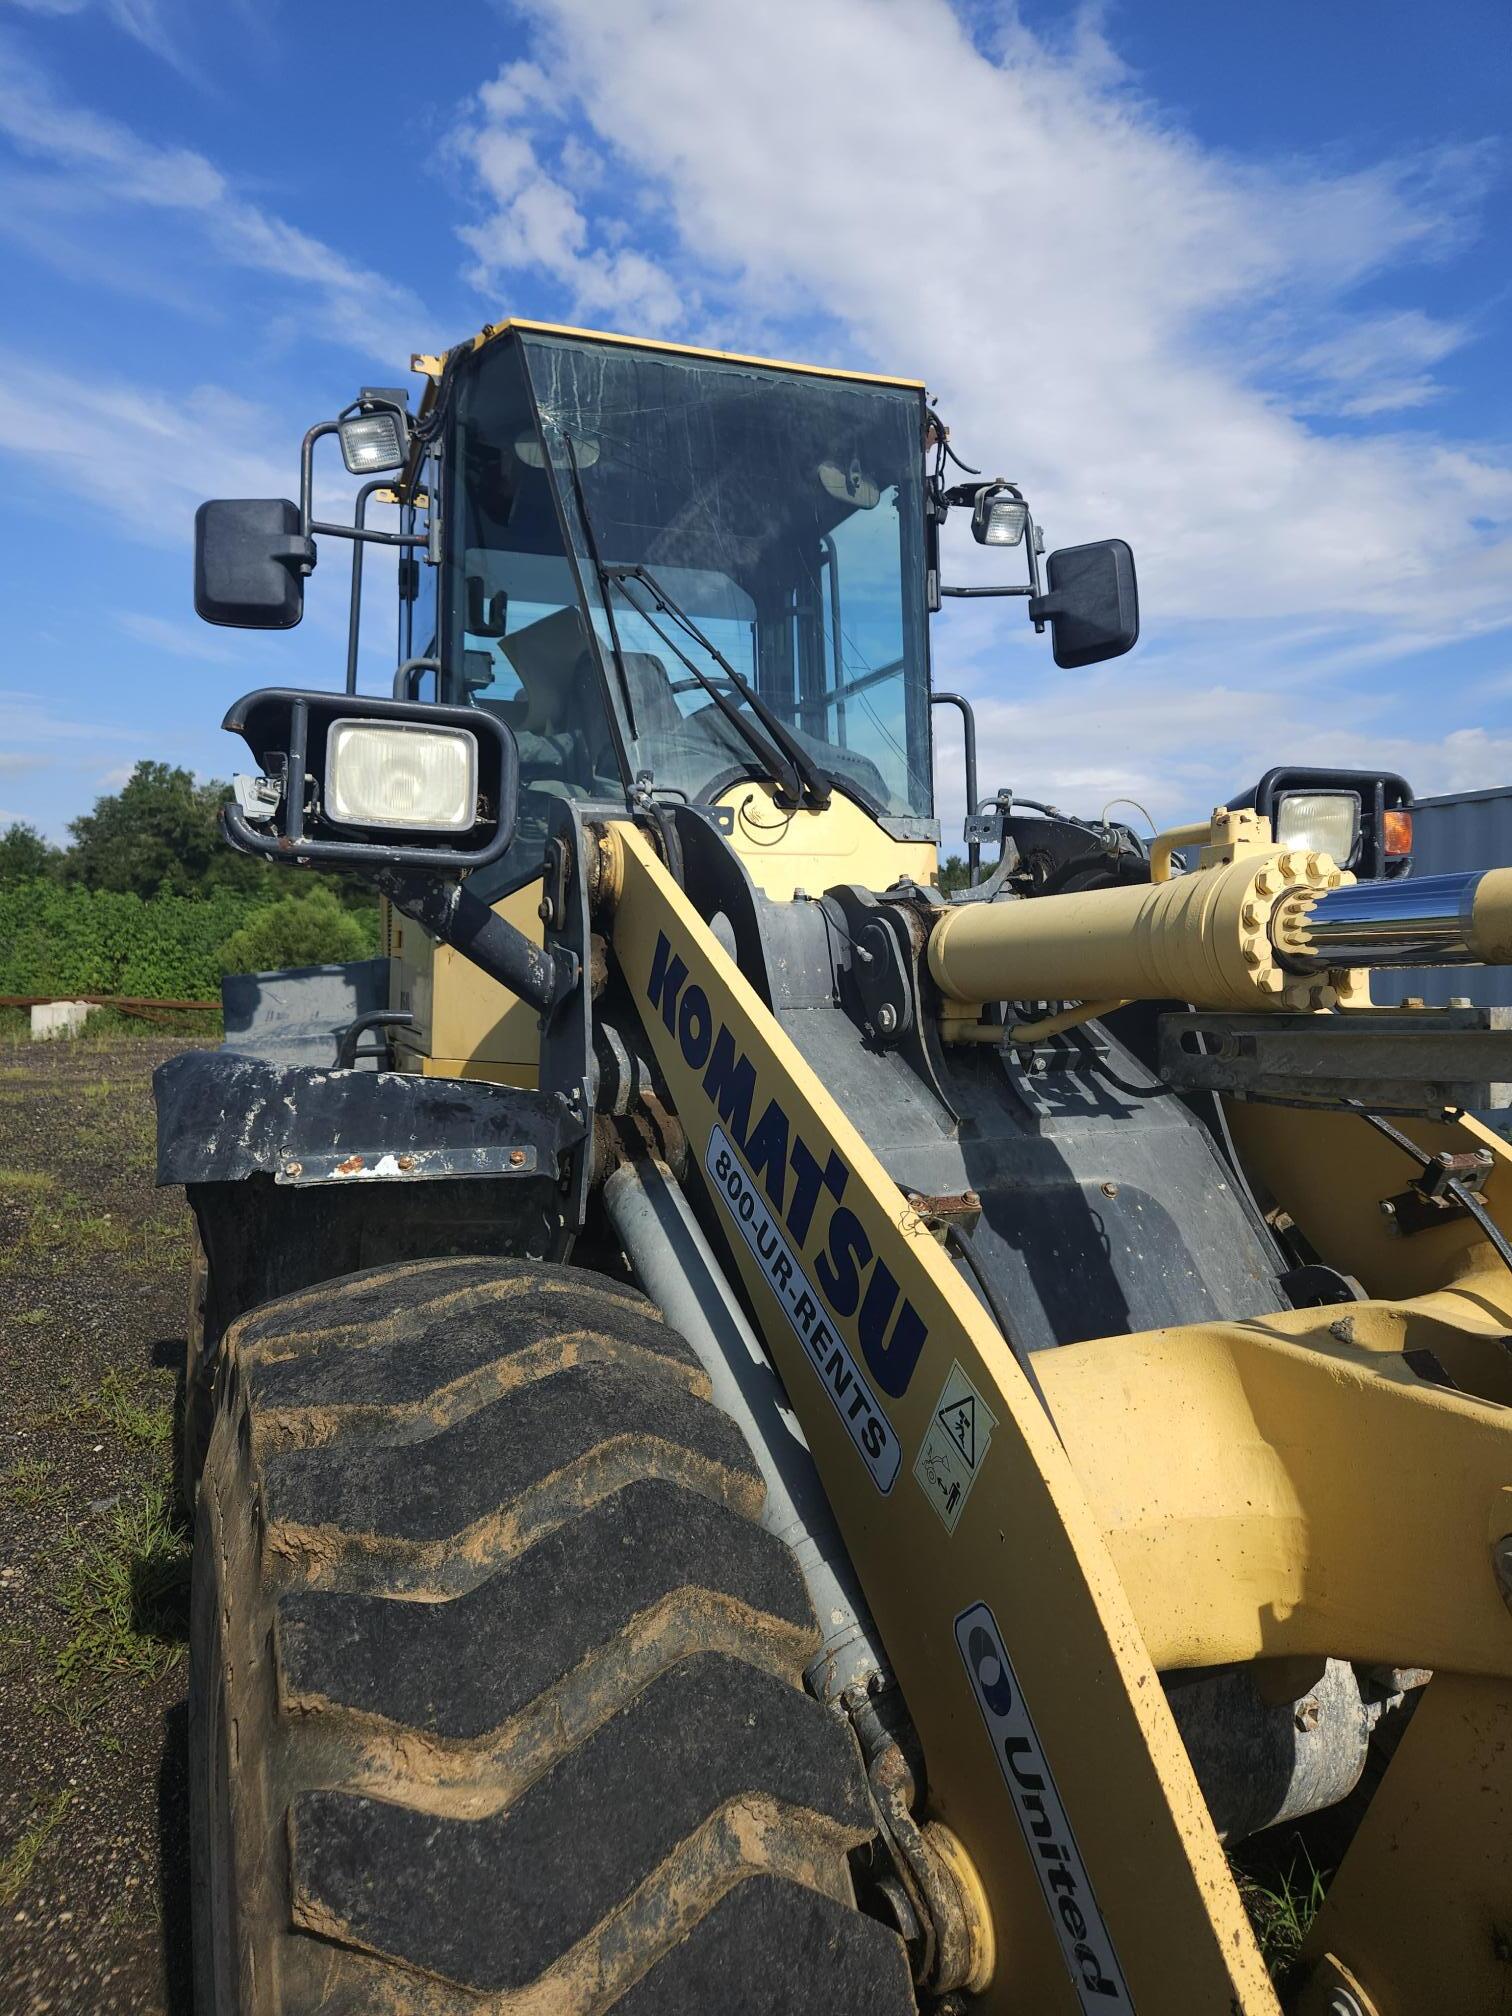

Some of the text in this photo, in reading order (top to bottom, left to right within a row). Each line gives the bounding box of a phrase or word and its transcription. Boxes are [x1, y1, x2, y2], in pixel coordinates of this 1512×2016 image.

[647, 930, 928, 1398] KOMATSU
[715, 1150, 886, 1458] 800-UR-RENTS
[1004, 1736, 1118, 1997] United
